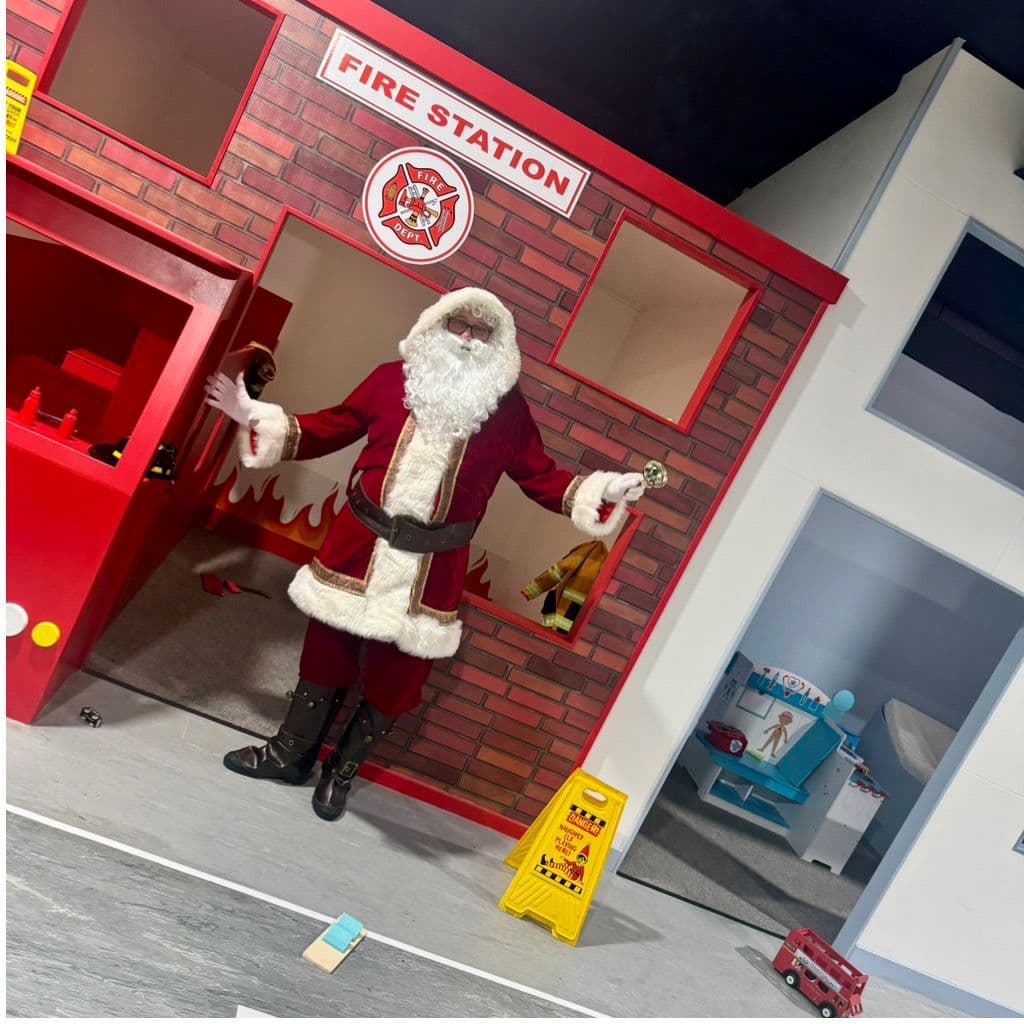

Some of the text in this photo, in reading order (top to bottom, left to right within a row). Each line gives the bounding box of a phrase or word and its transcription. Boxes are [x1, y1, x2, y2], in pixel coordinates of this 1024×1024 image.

[338, 53, 570, 196] FIRE STATION
[417, 171, 445, 191] FIRE
